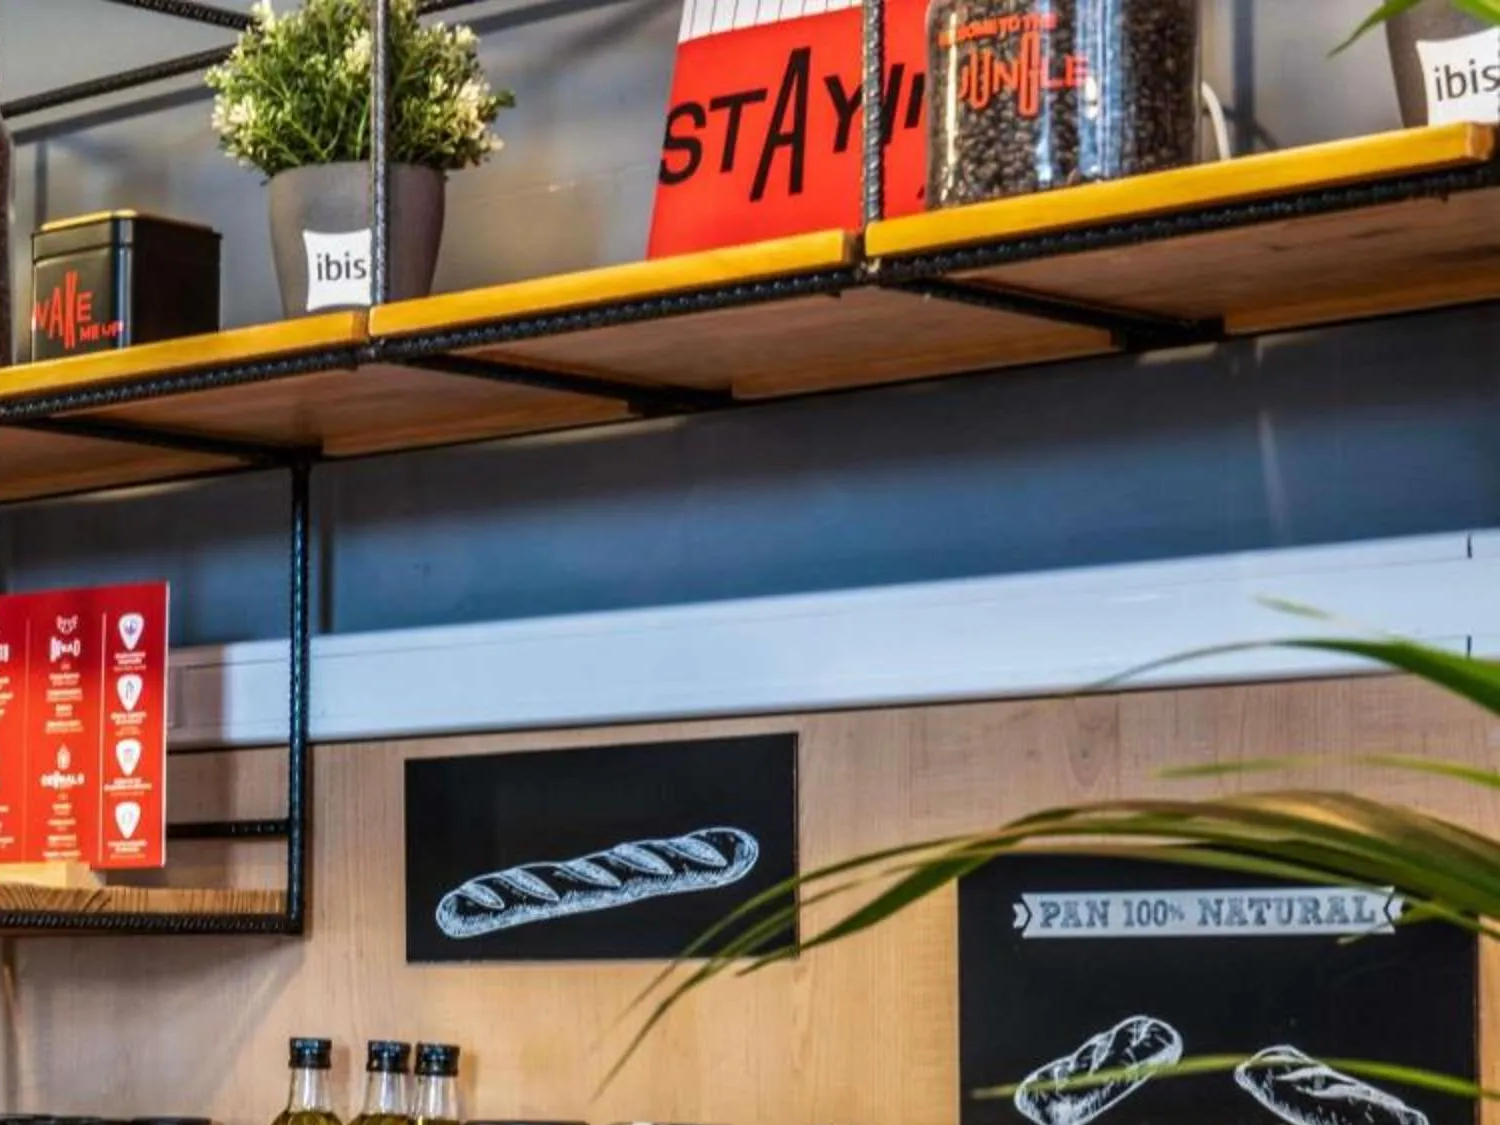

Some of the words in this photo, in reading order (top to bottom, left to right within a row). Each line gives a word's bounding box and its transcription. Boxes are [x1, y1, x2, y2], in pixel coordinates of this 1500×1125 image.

[1434, 58, 1500, 102] ibis
[658, 46, 925, 202] STAYI
[316, 250, 368, 283] ibis
[1039, 900, 1109, 929] PAN
[1122, 899, 1186, 928] 100%
[1198, 896, 1377, 927] NATURAL
